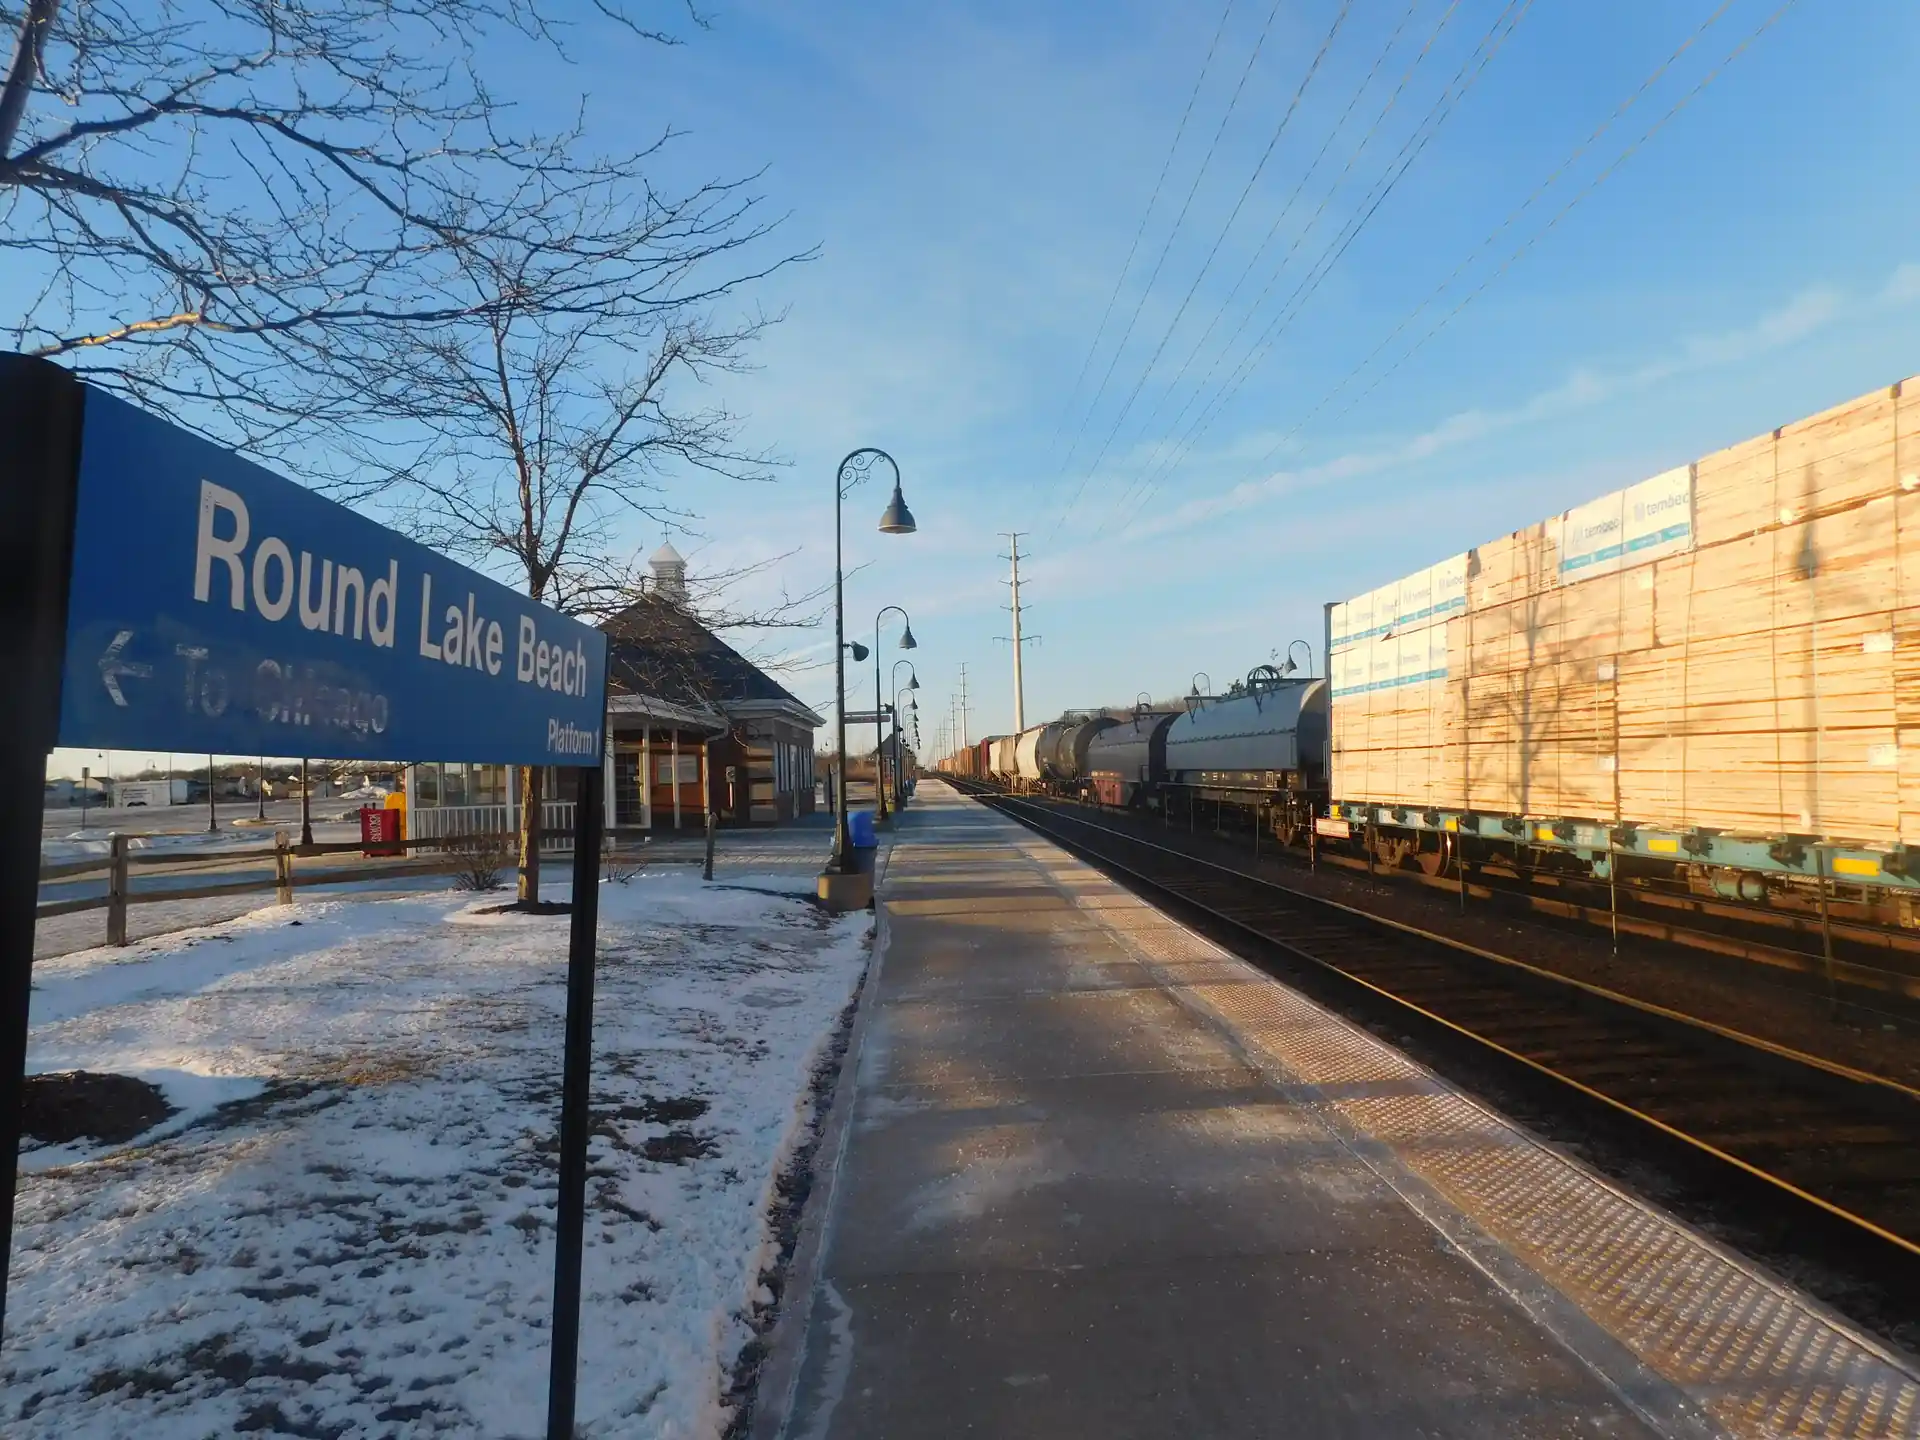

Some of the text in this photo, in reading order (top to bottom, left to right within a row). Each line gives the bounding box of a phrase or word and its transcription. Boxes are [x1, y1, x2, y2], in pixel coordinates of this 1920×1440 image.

[194, 479, 587, 698] Round Lake Beach
[176, 642, 229, 718] To
[547, 717, 600, 757] Platform 1
